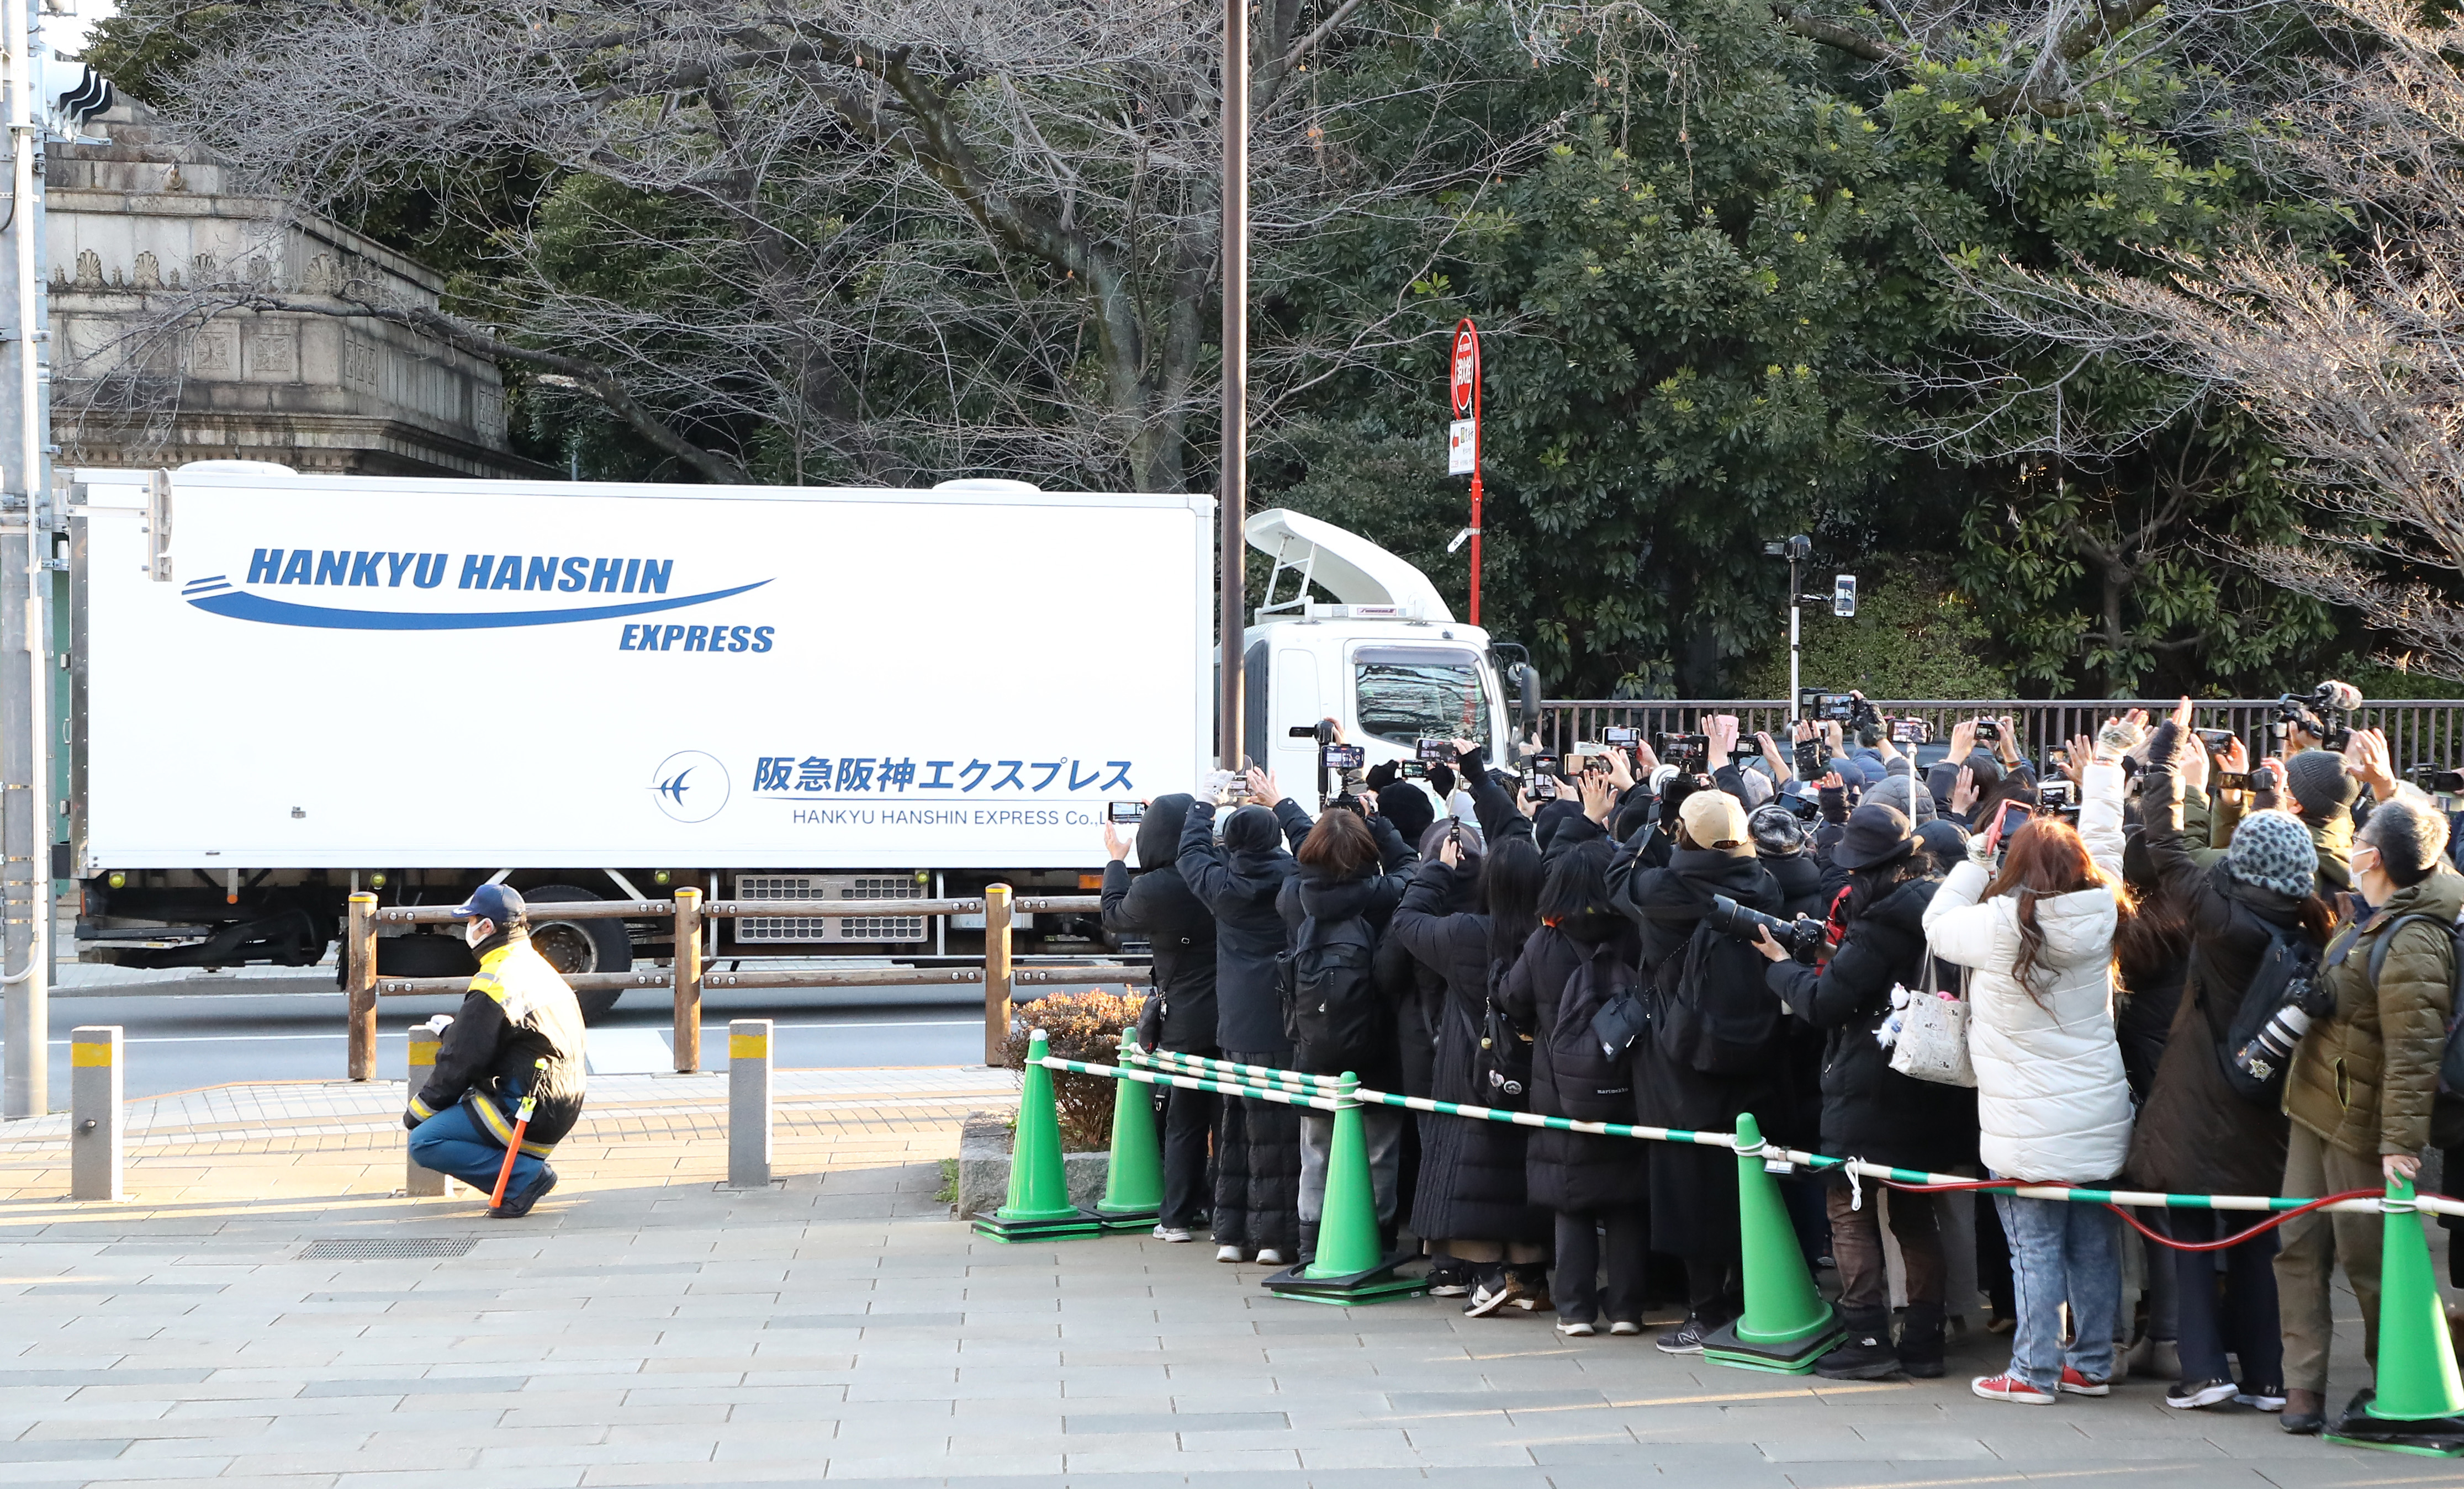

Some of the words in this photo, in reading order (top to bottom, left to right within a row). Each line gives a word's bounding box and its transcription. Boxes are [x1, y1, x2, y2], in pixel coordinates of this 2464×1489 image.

[1457, 355, 1472, 386] 消火栓
[246, 548, 449, 589] HANKYU
[458, 554, 674, 594] HANSHIN
[619, 624, 775, 653] EXPRESS
[753, 756, 1134, 792] 阪急阪神エクスプレス
[794, 809, 874, 824] HANKYU
[882, 810, 967, 824] HANSHIN
[975, 810, 1059, 825] EXPRESS
